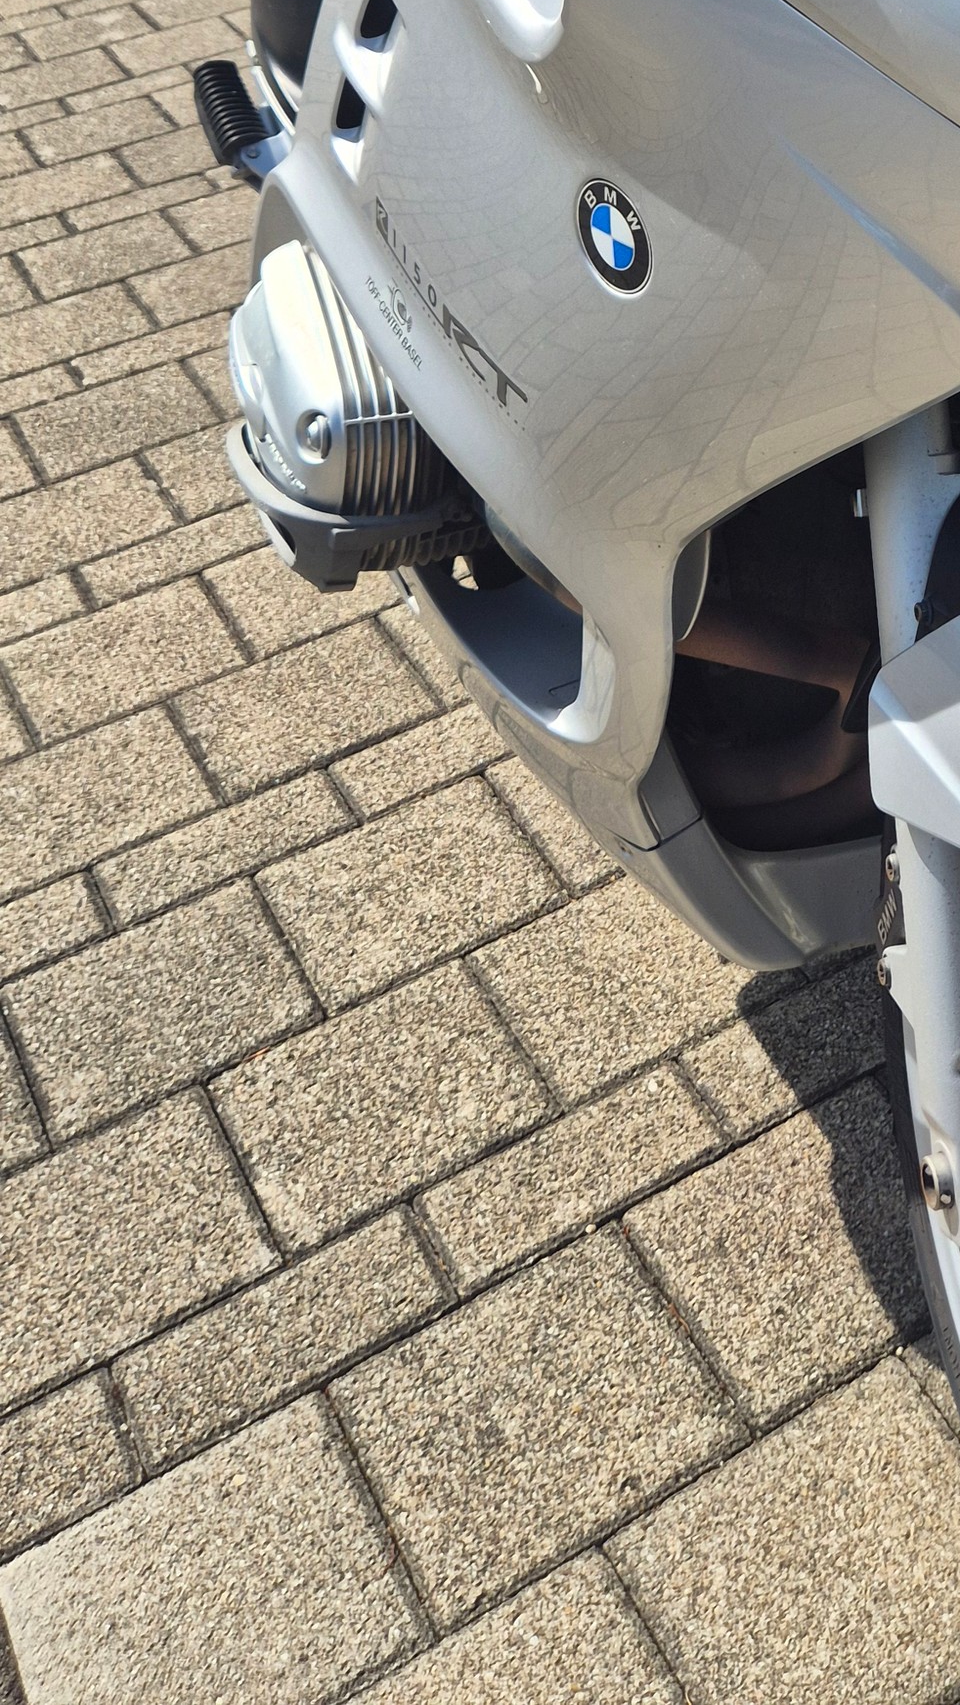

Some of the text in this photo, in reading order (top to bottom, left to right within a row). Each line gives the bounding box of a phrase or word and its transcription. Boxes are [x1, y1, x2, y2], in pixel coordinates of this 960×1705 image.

[584, 186, 641, 231] BMW
[400, 337, 423, 371] BASEL
[877, 888, 897, 946] BMW
